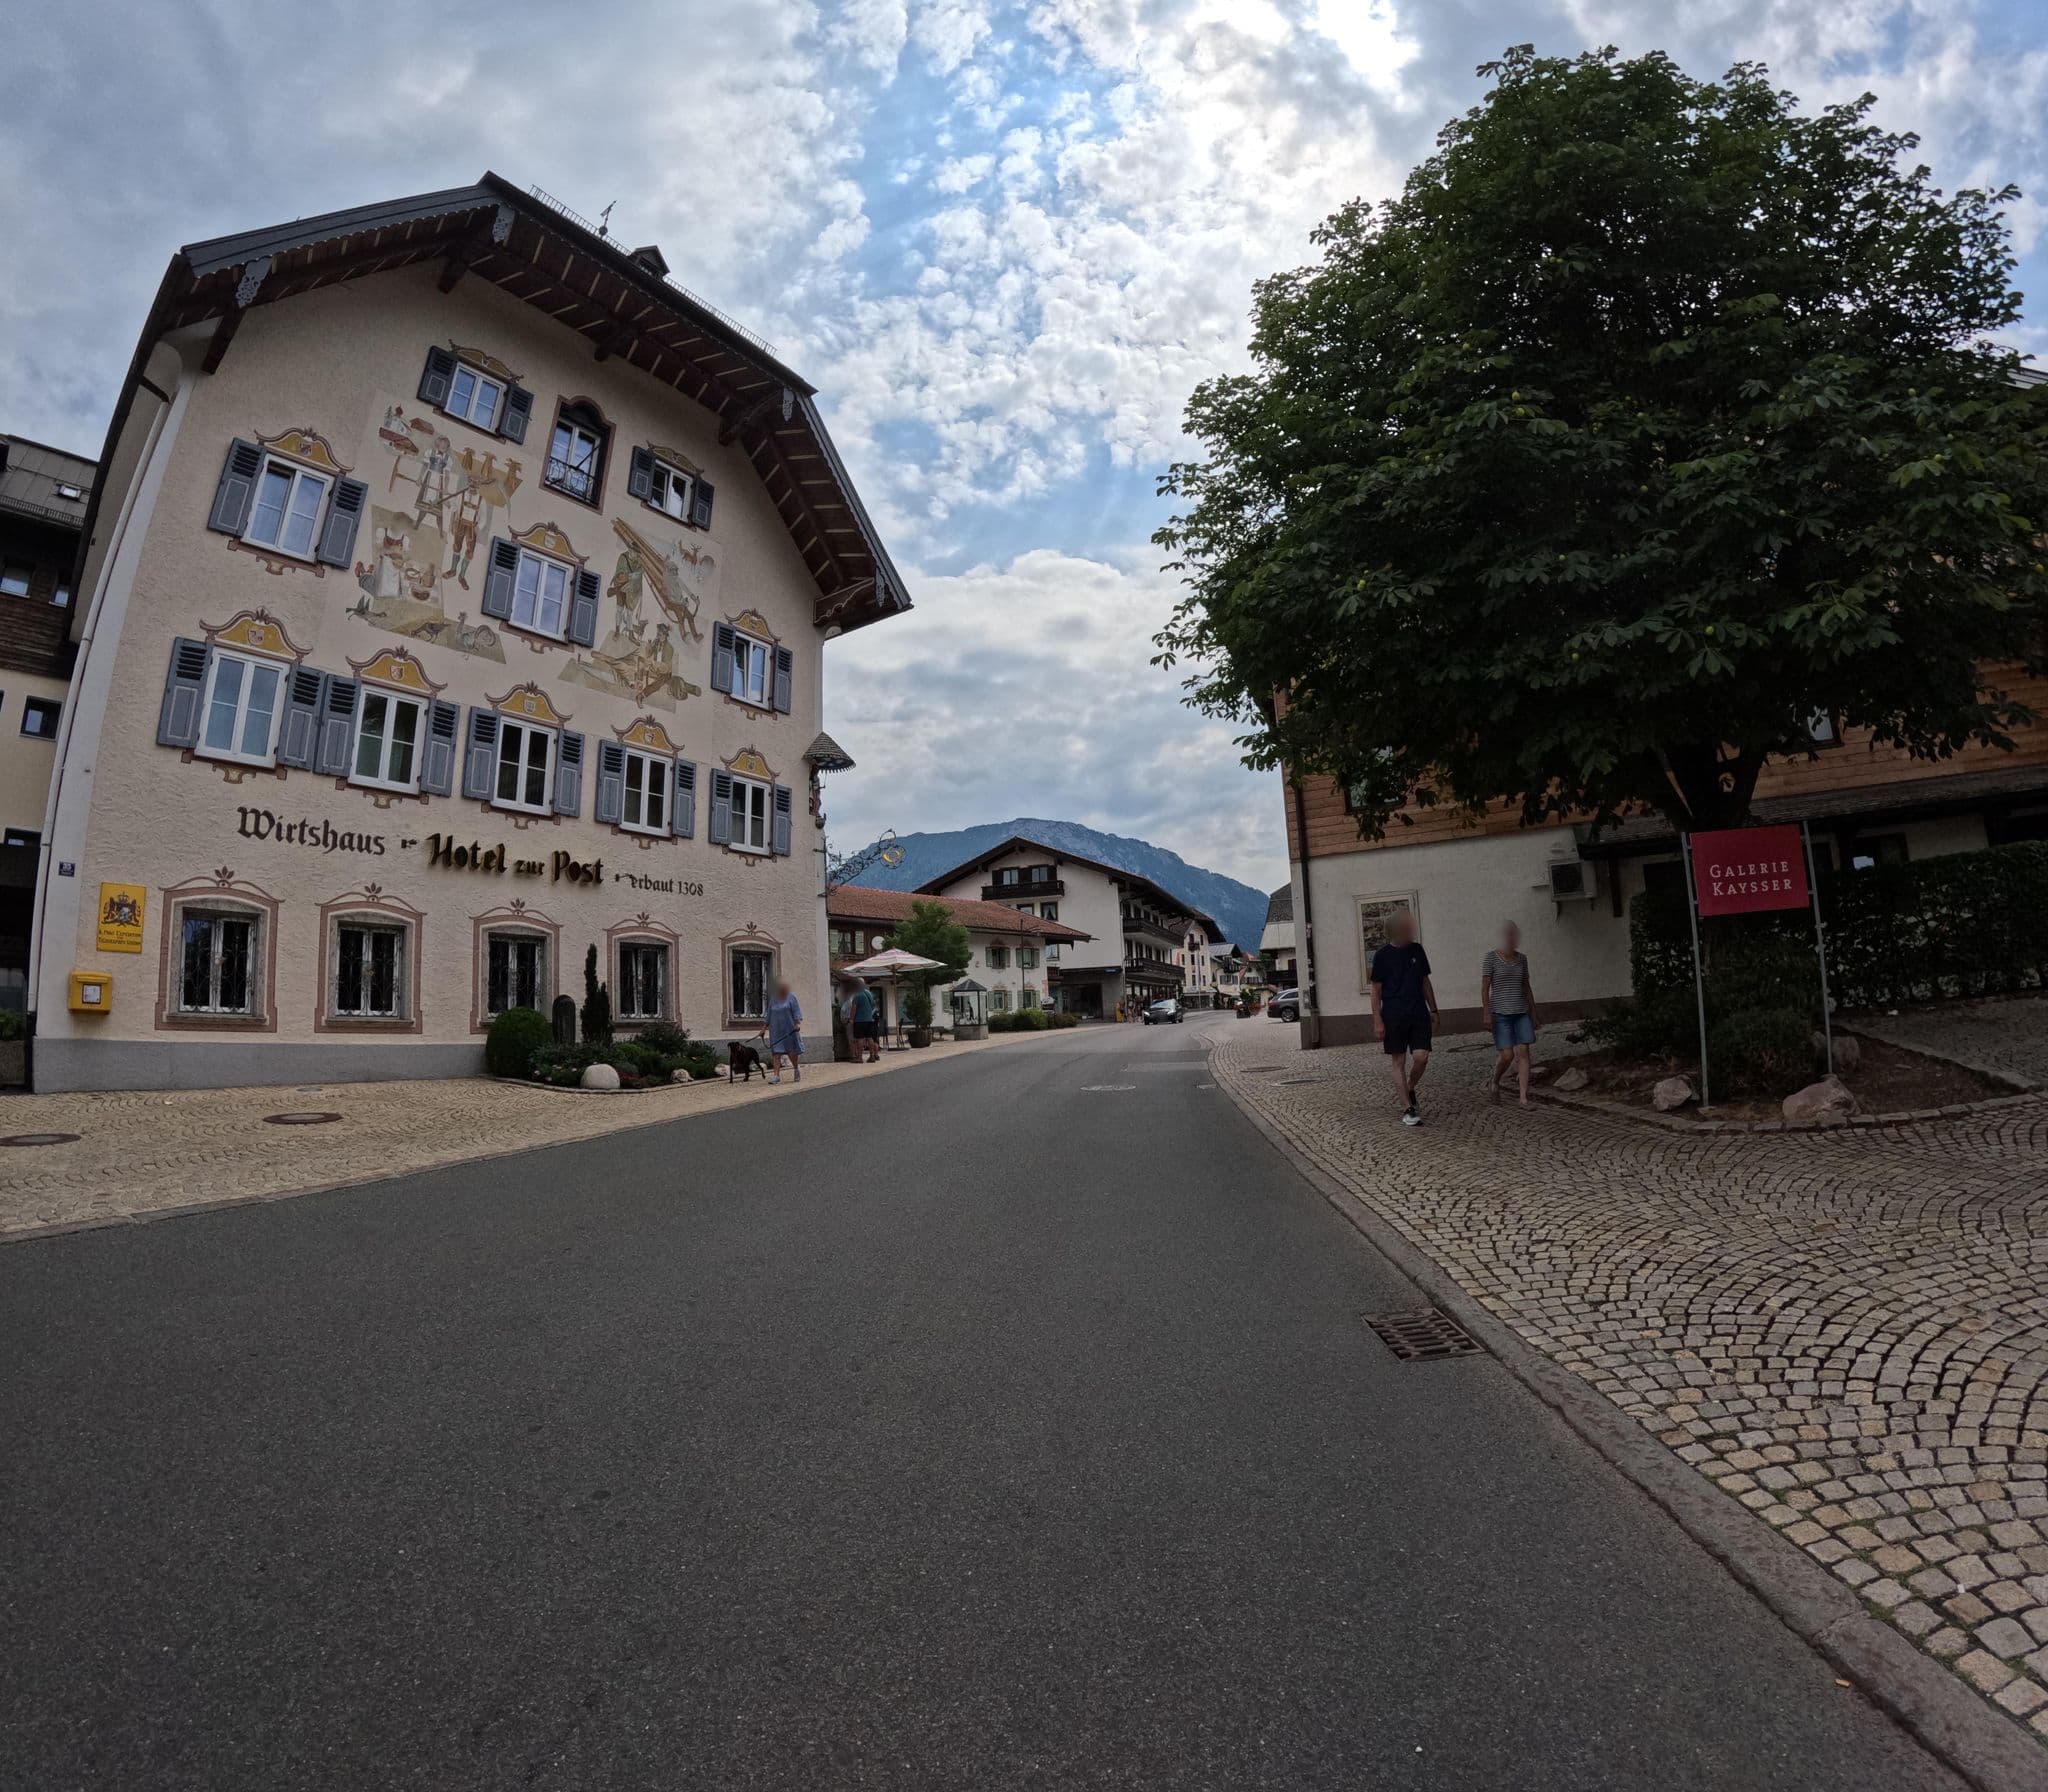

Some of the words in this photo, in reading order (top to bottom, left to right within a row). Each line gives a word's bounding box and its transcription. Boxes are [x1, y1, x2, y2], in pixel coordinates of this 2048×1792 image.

[237, 806, 385, 855] Wirtshaus
[426, 833, 507, 873] Hotel
[514, 859, 545, 876] zur
[552, 850, 604, 883] Post
[630, 874, 673, 893] erbaut
[678, 880, 704, 896] 1308
[1709, 861, 1789, 878] GALERIE
[1712, 879, 1792, 896] KAYSSER
